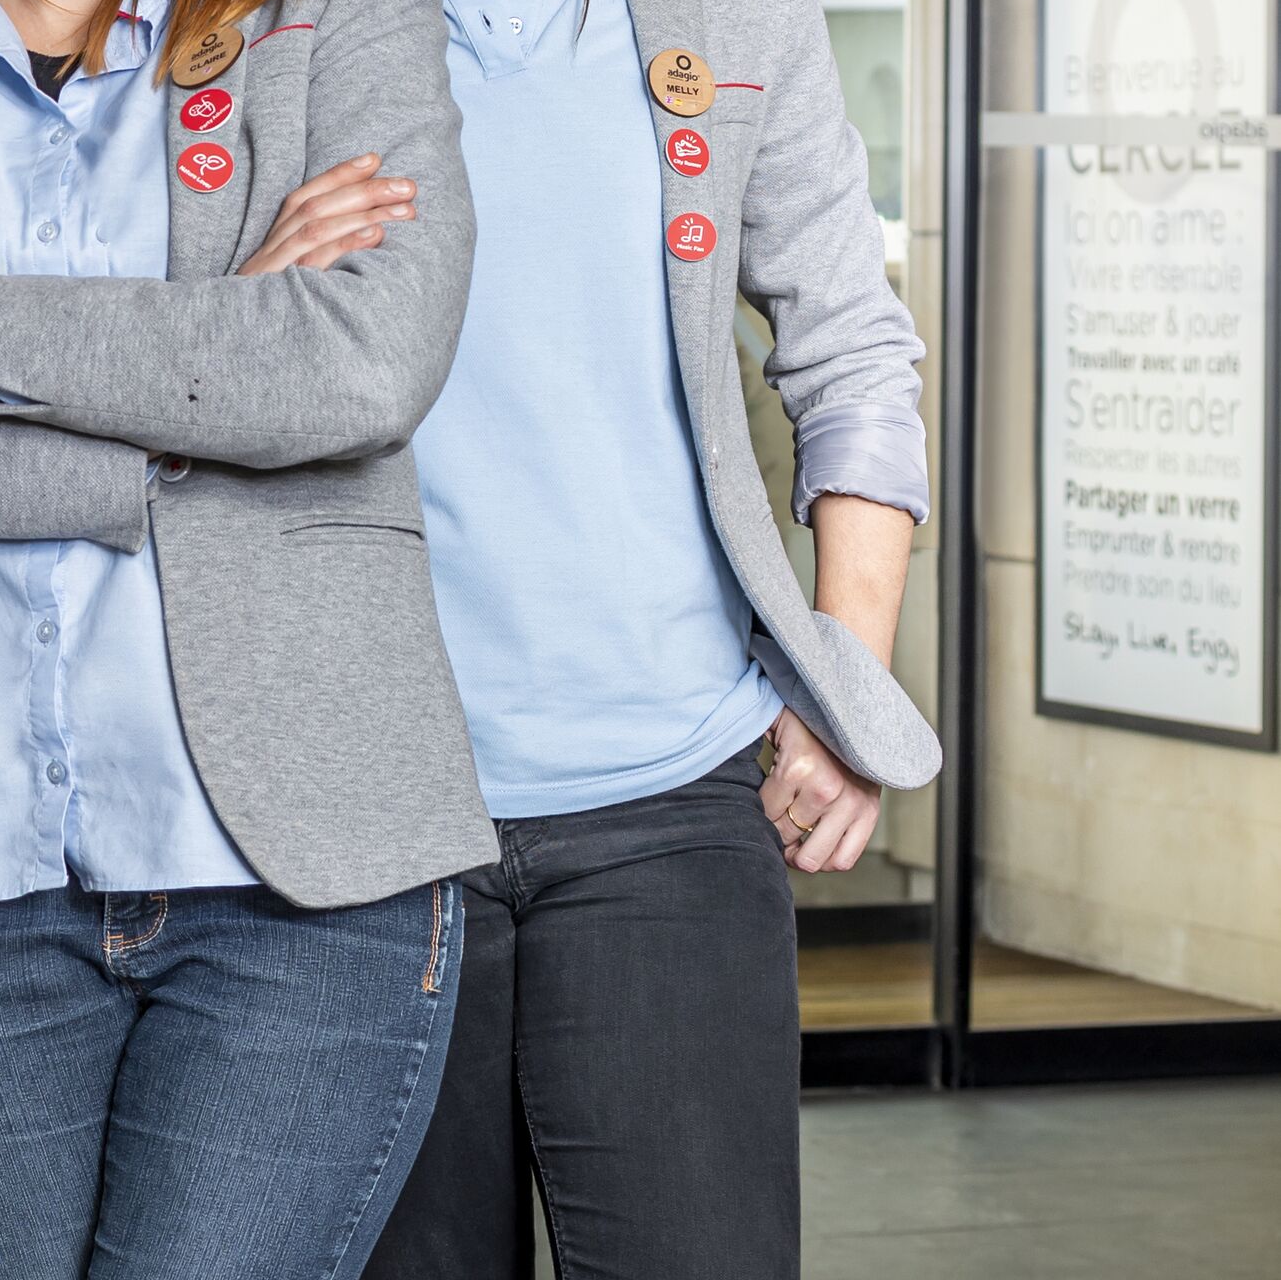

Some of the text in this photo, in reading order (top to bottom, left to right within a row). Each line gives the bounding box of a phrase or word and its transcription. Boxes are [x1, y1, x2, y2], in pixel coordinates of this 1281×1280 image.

[189, 51, 227, 72] CLAIRE
[191, 41, 224, 60] adagio
[666, 84, 700, 96] MELLY
[667, 68, 699, 82] adagio
[1065, 54, 1245, 97] Bienvenue au
[1104, 209, 1143, 248] on
[1151, 204, 1227, 247] aime
[1064, 254, 1243, 294] Vivre ensemble
[1165, 302, 1179, 338] &
[1184, 305, 1242, 346] jouer
[1066, 345, 1242, 378] Travailler avec un café
[1063, 477, 1241, 524] Partager un verre
[1063, 520, 1156, 560] Emprunter
[1179, 533, 1242, 566] rendre
[1063, 559, 1131, 597] Prendre
[1136, 569, 1175, 599] soin
[1186, 626, 1240, 679] Enjoy
